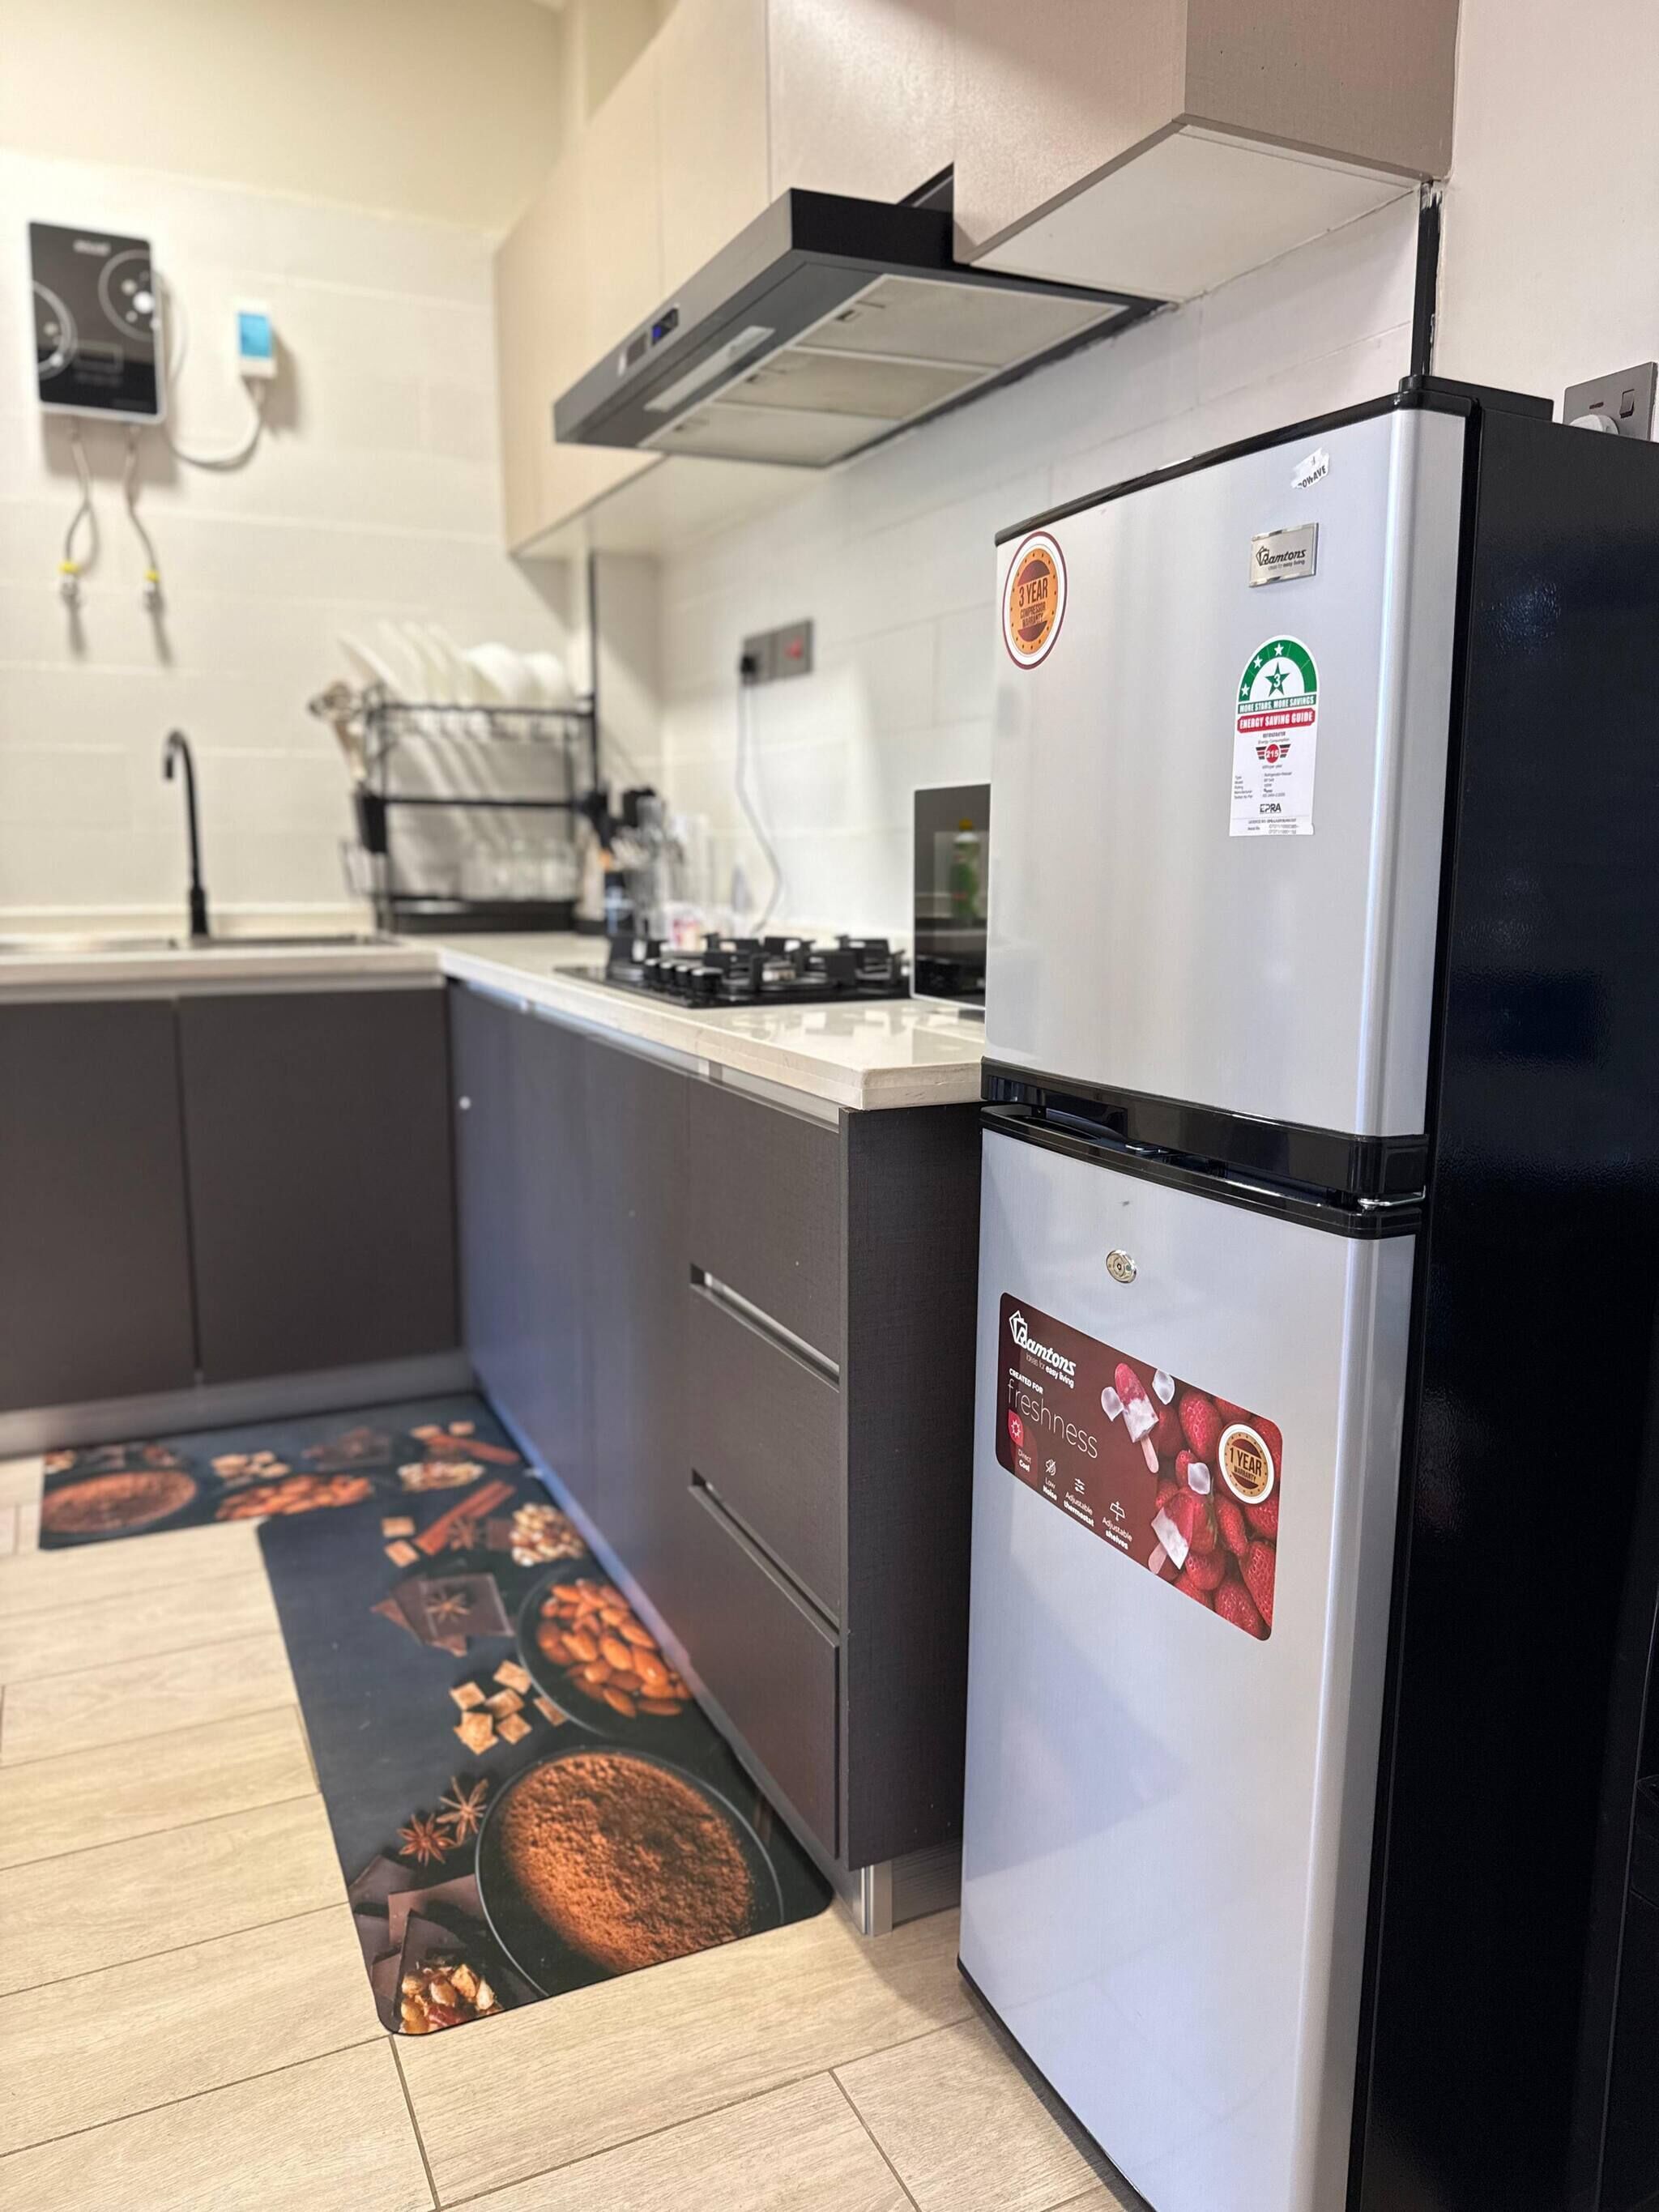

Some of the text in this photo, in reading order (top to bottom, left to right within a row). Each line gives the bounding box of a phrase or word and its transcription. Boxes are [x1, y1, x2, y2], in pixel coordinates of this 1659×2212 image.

[1260, 548, 1307, 566] Ramtons
[1019, 578, 1048, 607] 3 YEAR
[1021, 601, 1046, 619] COMPRESSOR
[1022, 612, 1044, 627] WARRANTY
[1273, 673, 1281, 688] 3
[1239, 703, 1254, 714] MORE
[1273, 699, 1289, 710] MORE
[1290, 696, 1314, 708] SAVINGS
[1239, 711, 1313, 730] ENERGY SAVING GUIDE
[1266, 749, 1279, 758] 215
[1014, 1320, 1076, 1376] Ramtons
[1009, 1368, 1043, 1394] CREATED FOR
[1045, 1366, 1059, 1379] easy
[1059, 1372, 1074, 1389] living
[1008, 1379, 1098, 1458] freshness
[1230, 1447, 1262, 1477] 1 YEAR
[1045, 1477, 1056, 1489] Low
[1234, 1465, 1256, 1482] WARRANTY
[1064, 1500, 1094, 1527] thermostat
[1065, 1492, 1093, 1515] Adjustable
[1102, 1517, 1132, 1542] Adjustable
[1105, 1529, 1128, 1549] shelves
